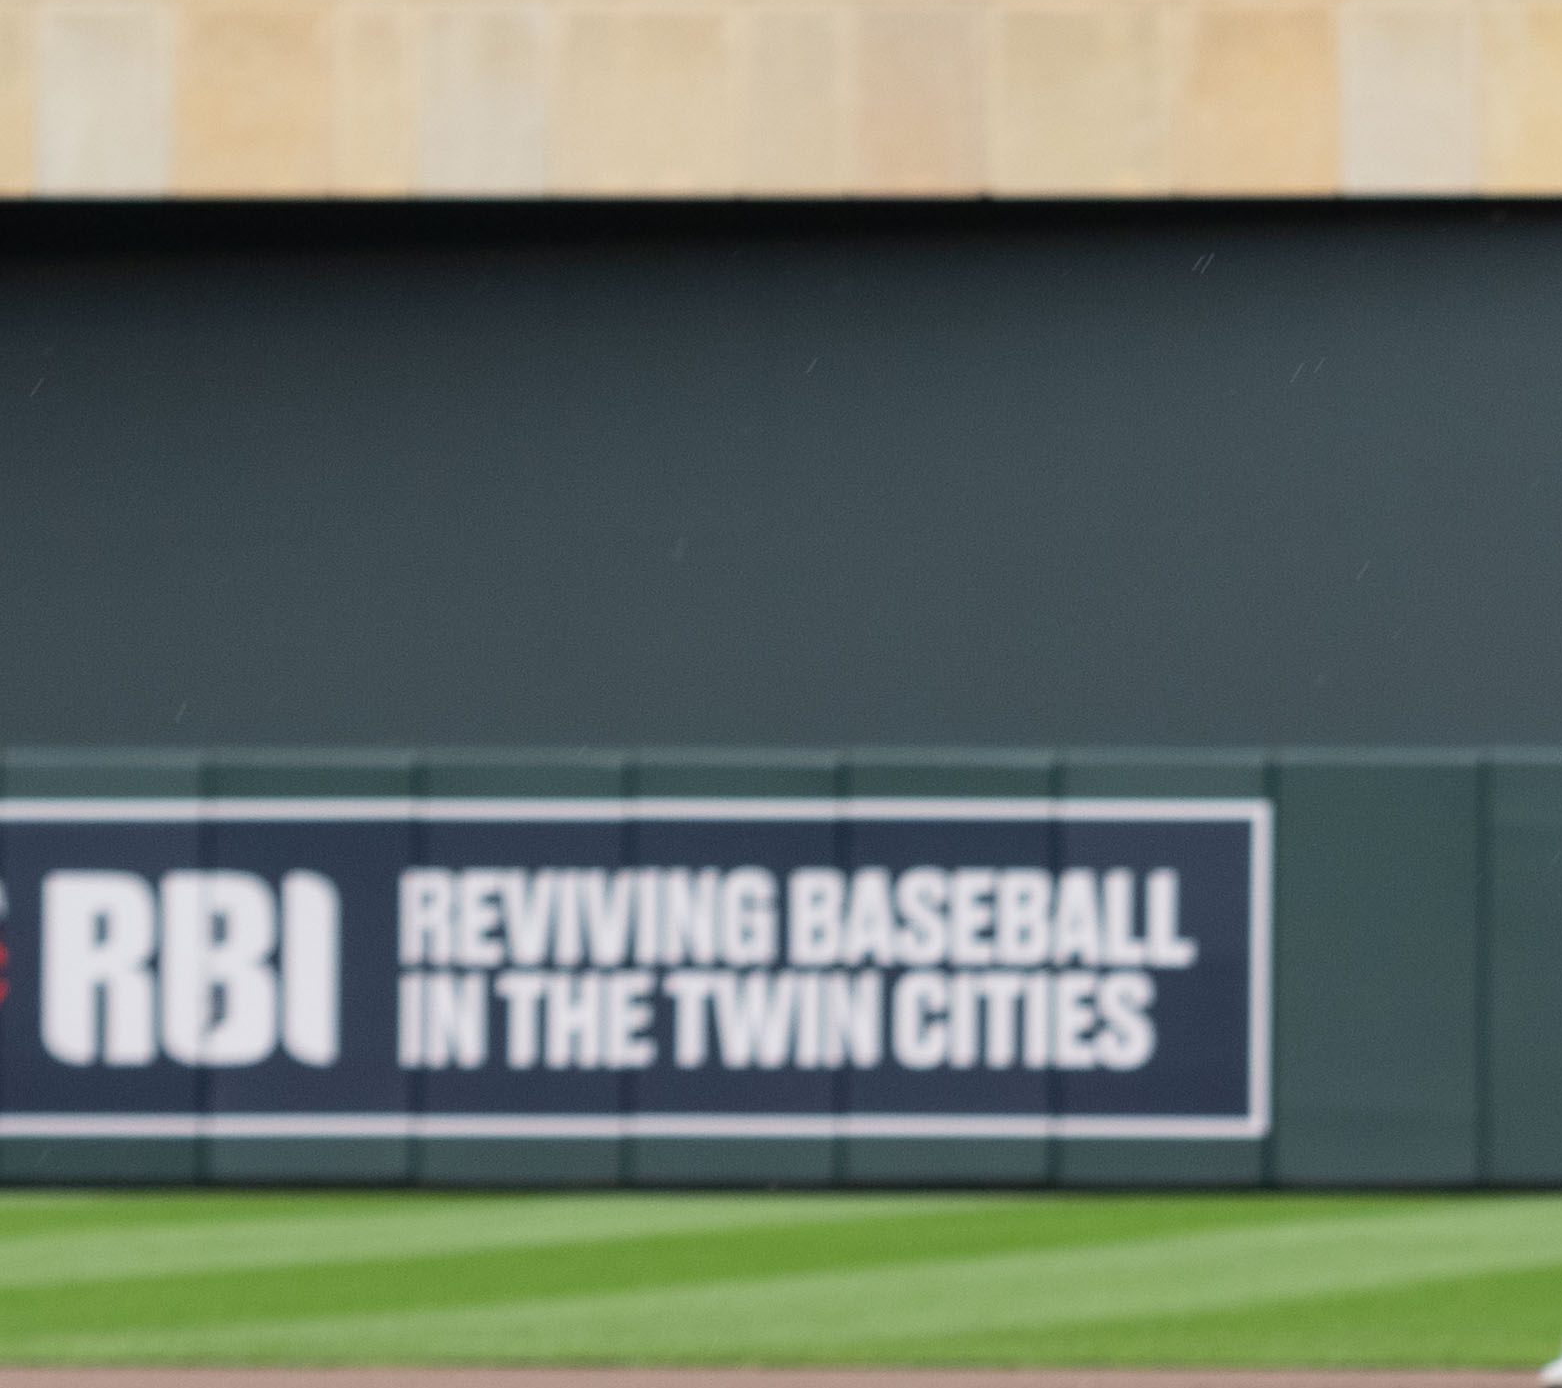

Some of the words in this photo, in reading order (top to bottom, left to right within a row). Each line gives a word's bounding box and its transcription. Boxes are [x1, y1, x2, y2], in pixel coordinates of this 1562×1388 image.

[40, 867, 340, 1067] RBI
[399, 868, 780, 968] REVIVING
[789, 868, 1196, 969] BASEBALL
[399, 969, 490, 1069] IN
[495, 969, 656, 1069] THE
[665, 969, 882, 1069] TWIN
[890, 969, 1157, 1069] CITIES
